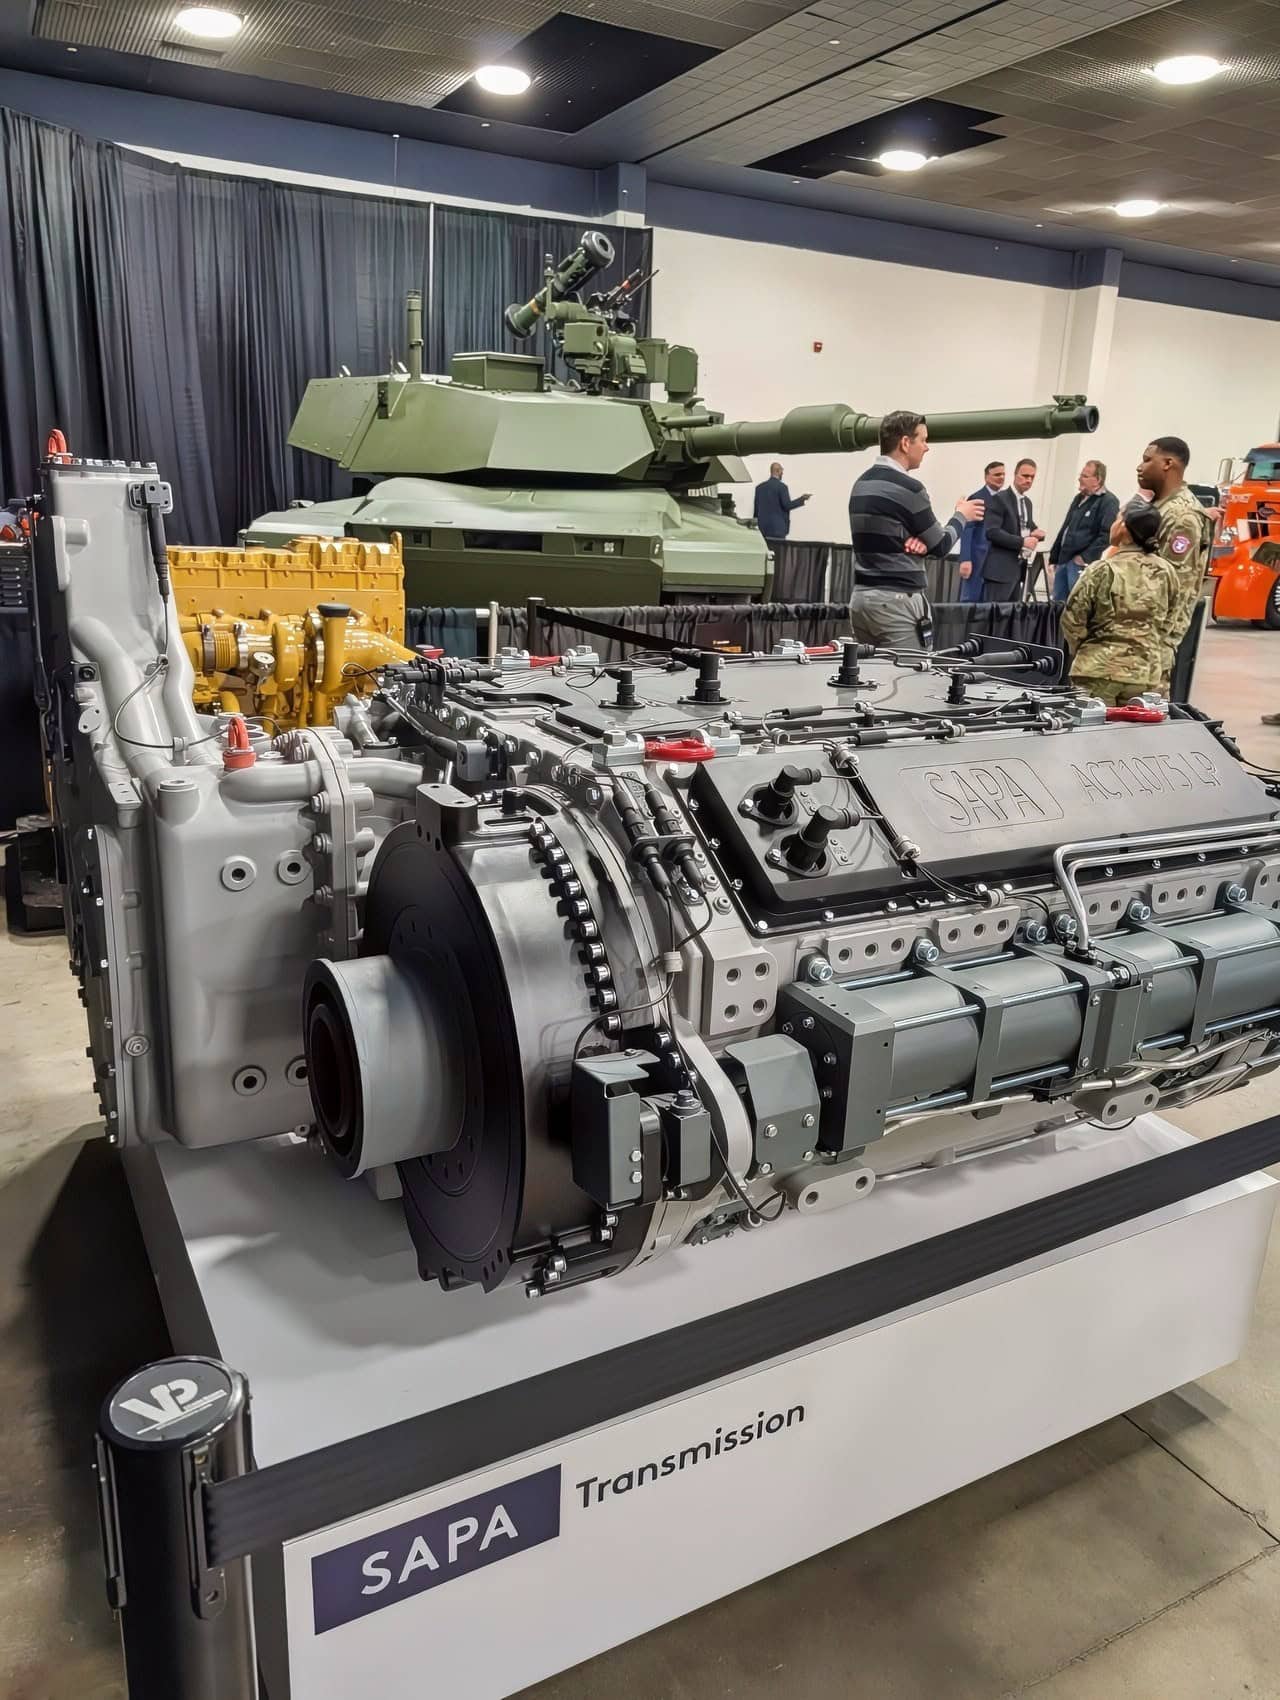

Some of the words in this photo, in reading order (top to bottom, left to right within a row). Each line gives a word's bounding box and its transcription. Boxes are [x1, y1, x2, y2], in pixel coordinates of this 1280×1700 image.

[923, 765, 1046, 827] SAPA
[360, 1504, 519, 1596] SAPA
[575, 1403, 806, 1509] Transmission
